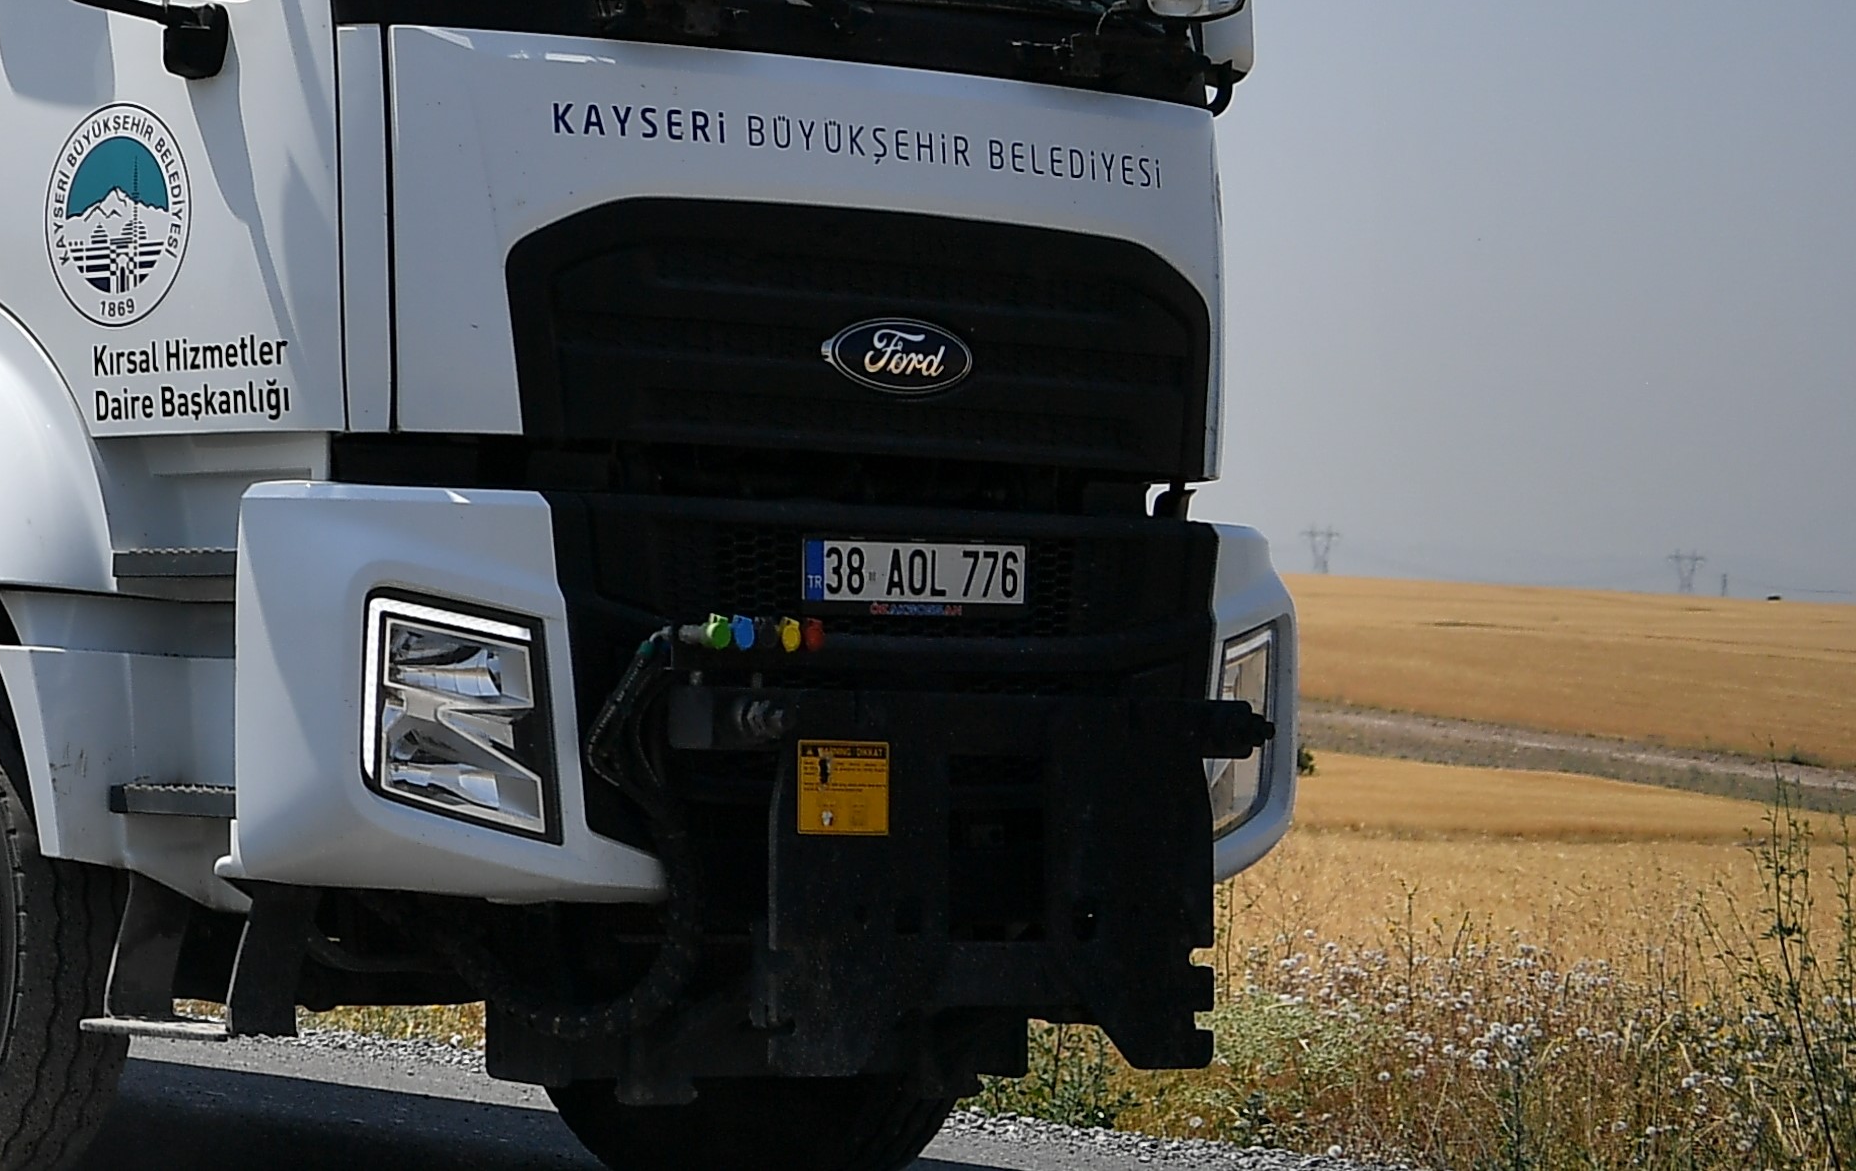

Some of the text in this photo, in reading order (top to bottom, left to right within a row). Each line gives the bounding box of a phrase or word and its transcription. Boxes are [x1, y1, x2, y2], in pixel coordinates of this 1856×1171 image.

[100, 297, 136, 318] 1869
[93, 334, 289, 377] Kırsal Hizmetler
[863, 328, 946, 378] Ford
[95, 378, 291, 422] Daire Başkanlığı
[807, 546, 1020, 599] TR 38 AOL 776
